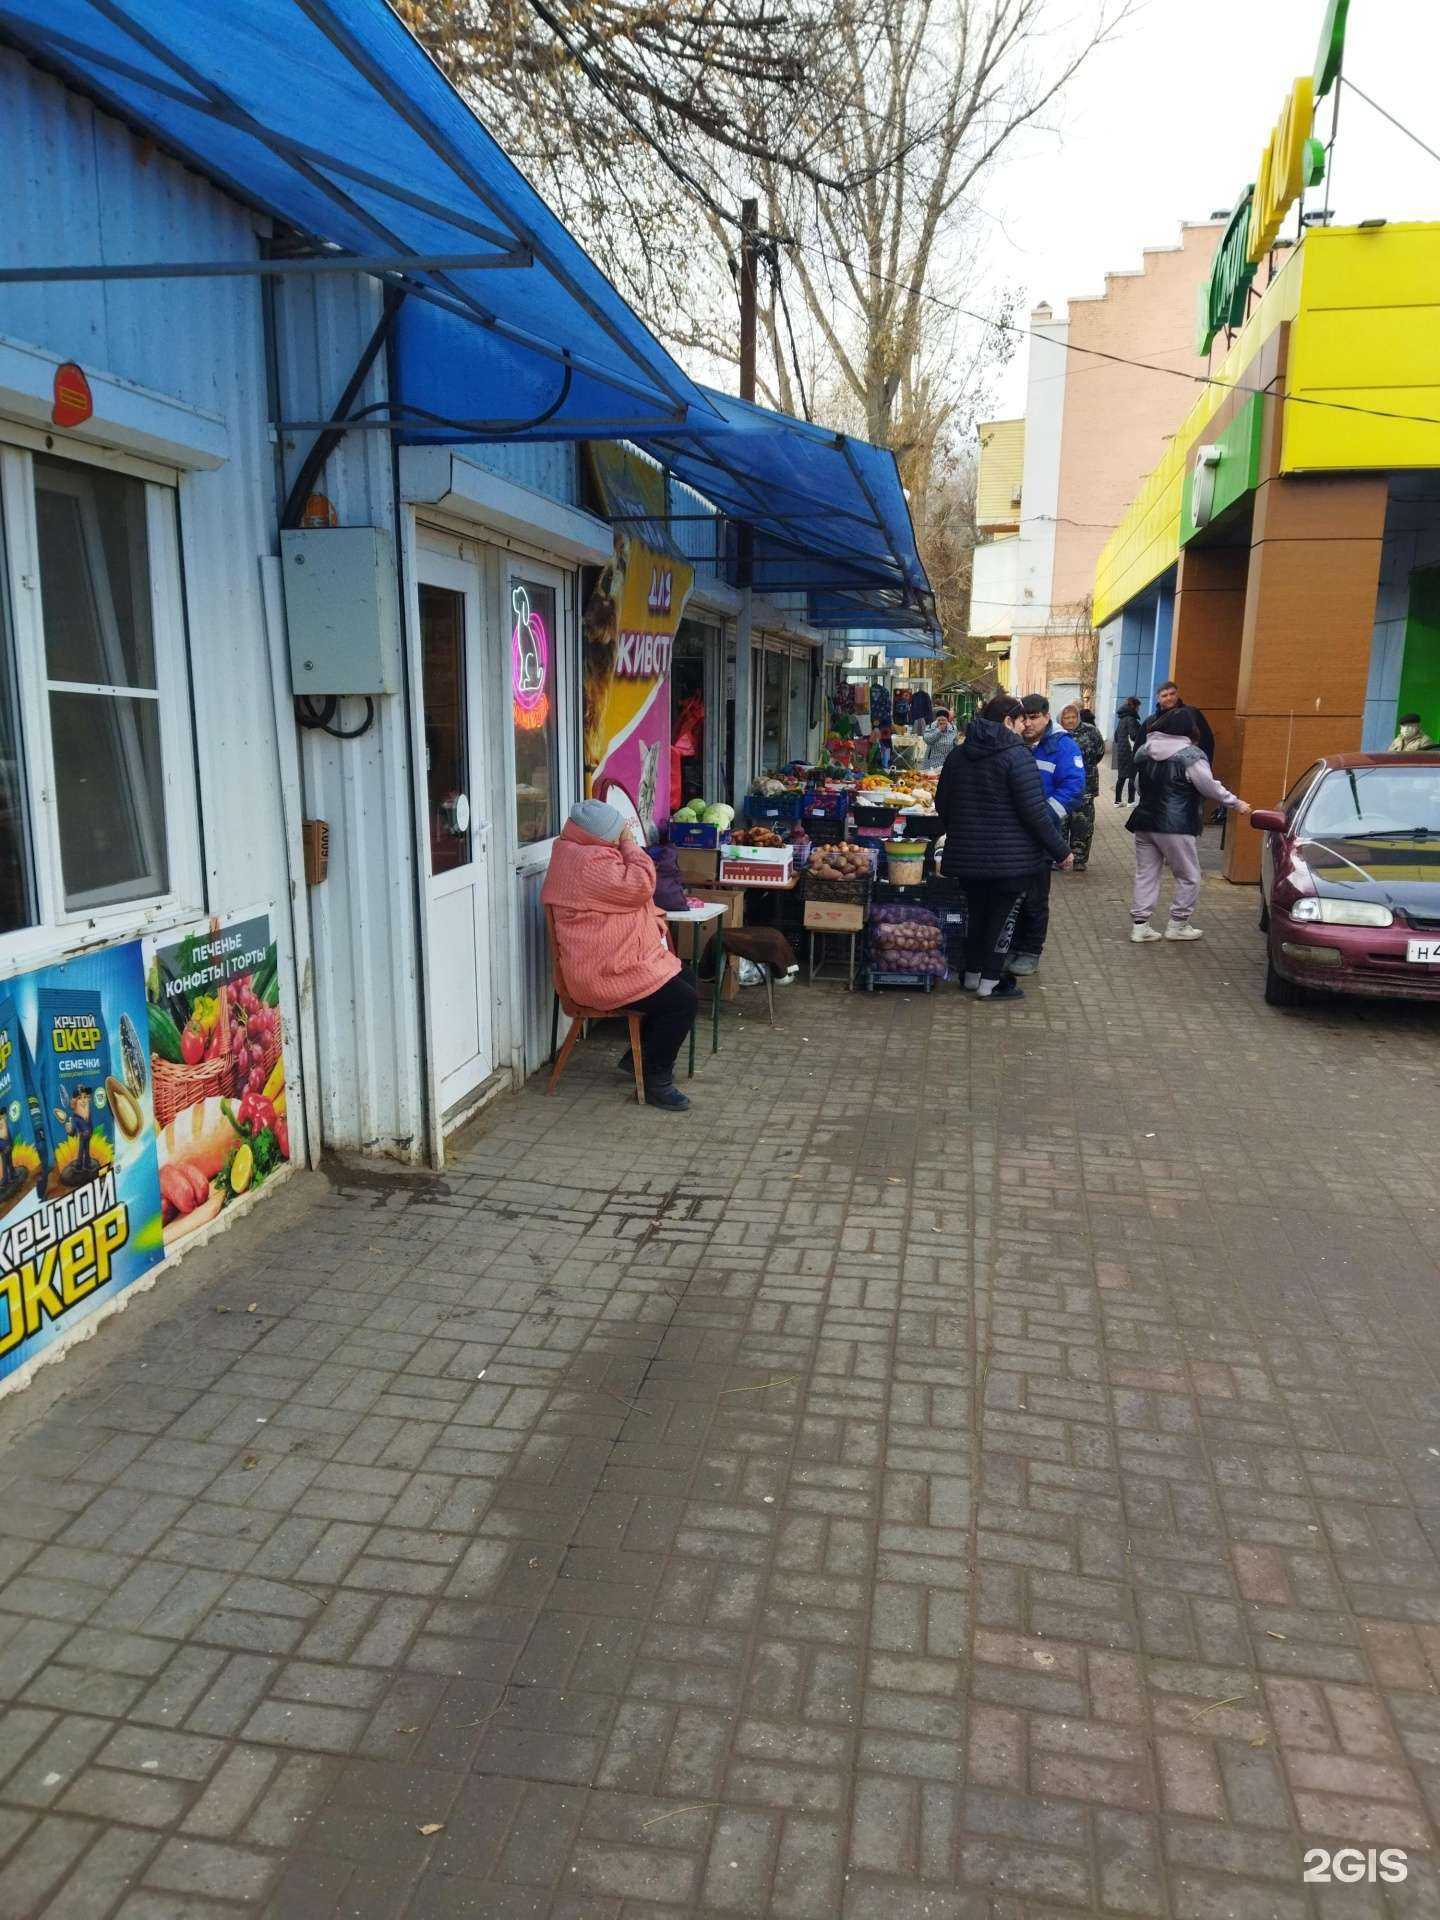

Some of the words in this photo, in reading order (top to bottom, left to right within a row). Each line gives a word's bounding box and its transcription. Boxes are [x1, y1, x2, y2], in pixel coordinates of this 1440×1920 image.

[648, 567, 671, 607] ДЛЯ
[192, 934, 242, 963] ПЕЧЕНЬЕ
[166, 964, 223, 998] КОНФЕТЫ
[232, 947, 266, 972] ТОРТЫ
[53, 1014, 96, 1028] КРУТОЙ
[59, 1058, 100, 1070] СЕМЕЧКИ
